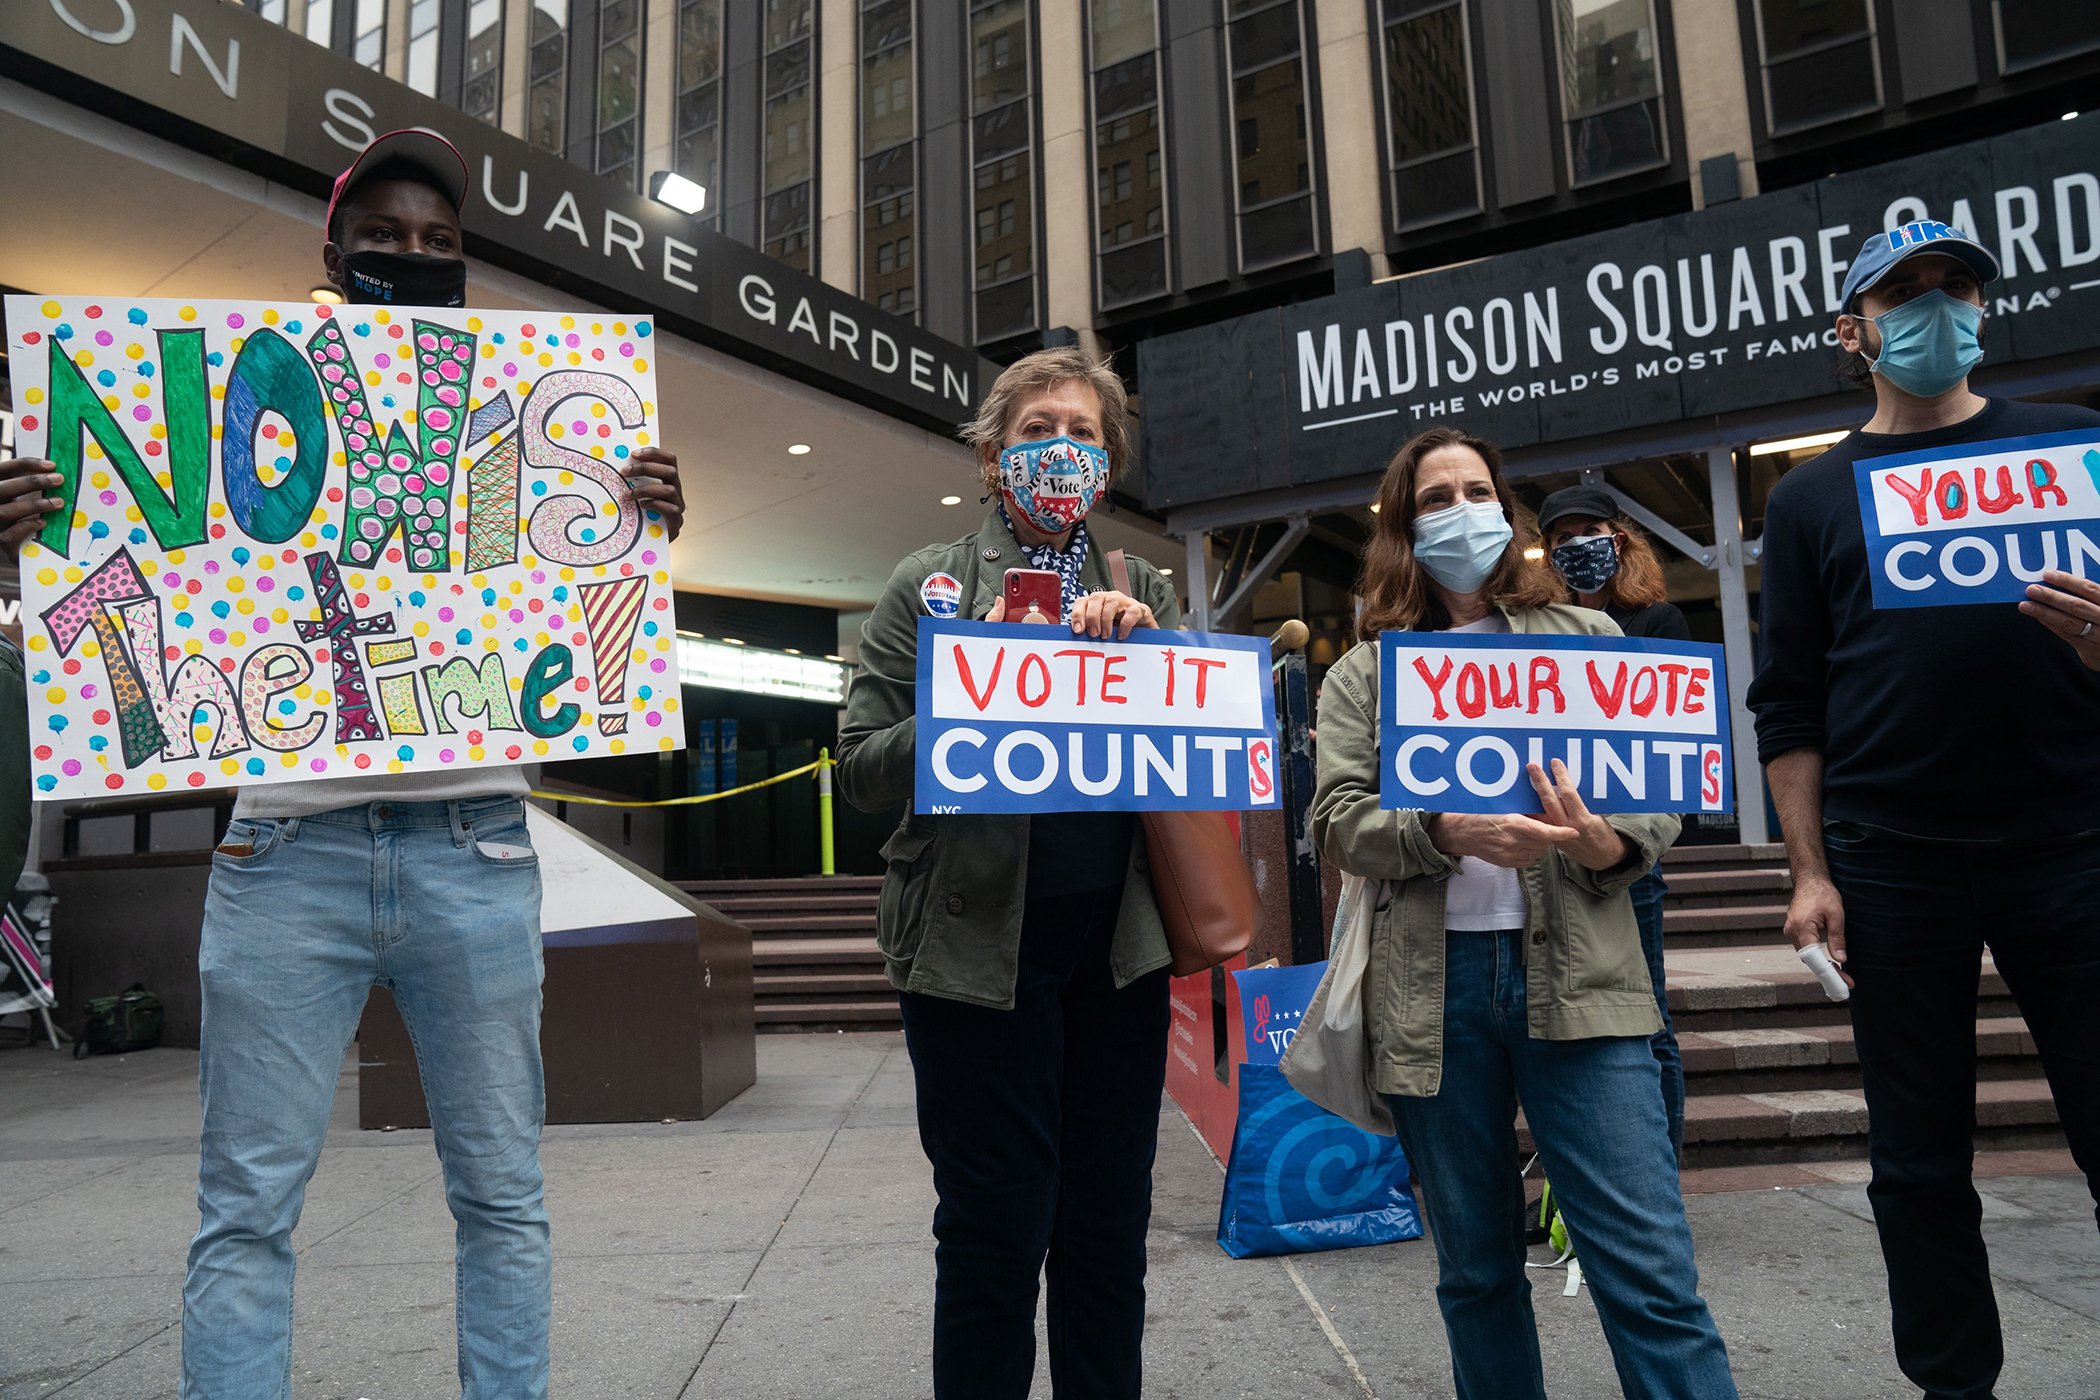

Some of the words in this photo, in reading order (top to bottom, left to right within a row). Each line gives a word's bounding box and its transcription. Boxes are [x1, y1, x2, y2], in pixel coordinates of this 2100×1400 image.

[320, 88, 699, 293] SUARE
[738, 273, 970, 407] GARDEN
[352, 270, 380, 286] UNITED
[382, 281, 394, 290] BY
[354, 278, 393, 301] HOPE
[1297, 286, 1563, 413] MADISON
[1587, 223, 1850, 355] SQUARE
[1410, 396, 1465, 420] THE
[1478, 368, 1620, 408] WORLD'S
[1637, 347, 1728, 380] MOST
[1746, 328, 1841, 361] FAMO
[36, 317, 478, 573] NOW
[1043, 477, 1080, 495] Vote
[1885, 458, 2068, 527] YOUR
[38, 544, 327, 769] The
[953, 643, 1128, 712] VOTE
[1412, 655, 1567, 721] YOUR
[1585, 659, 1711, 720] VOTE
[1267, 1028, 1298, 1055] VO
